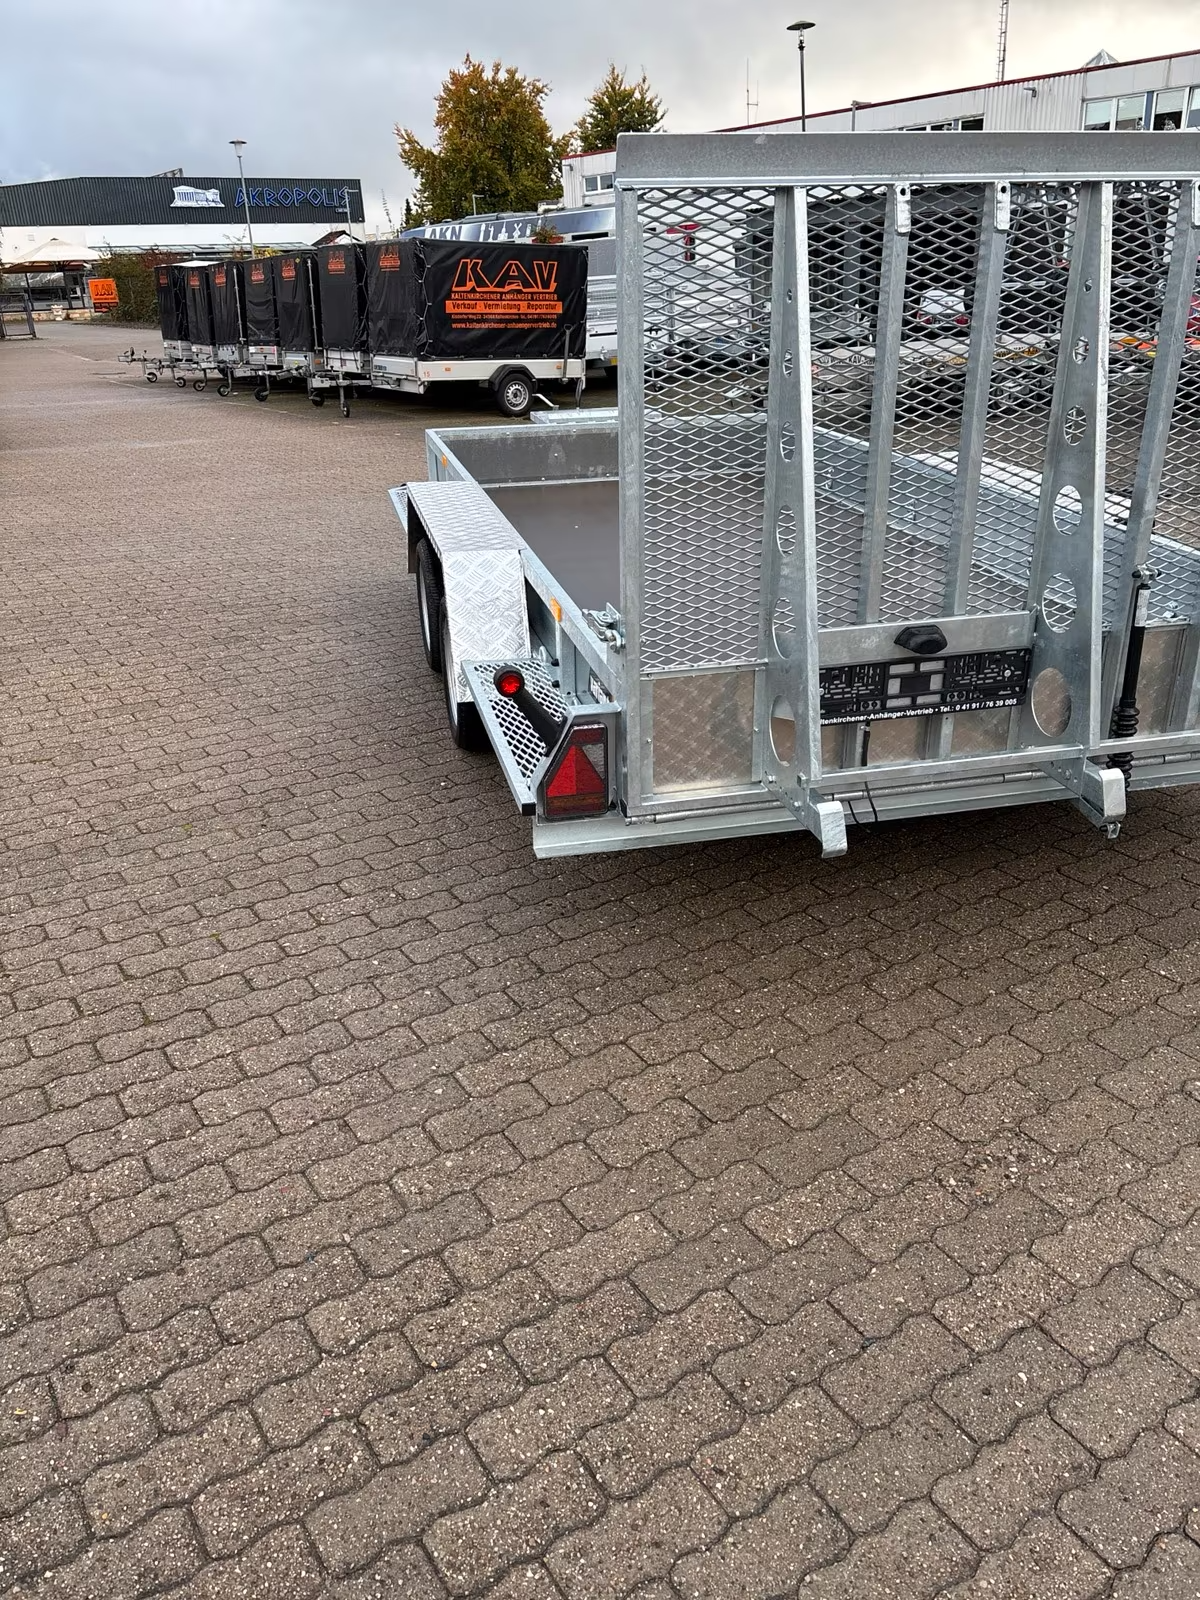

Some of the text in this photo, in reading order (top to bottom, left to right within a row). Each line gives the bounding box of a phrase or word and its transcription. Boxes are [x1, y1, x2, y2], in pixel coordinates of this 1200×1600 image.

[234, 186, 350, 207] AKROPOLIS
[429, 226, 462, 241] AKN
[452, 259, 558, 292] KAV
[451, 291, 558, 301] KALTENKIRCHENER ANHÄNGER VERTRIEB
[452, 302, 558, 312] Verkauf Vermietung Reparatur
[820, 707, 934, 725] ltenkirchener-Anhänger-Vertrieb
